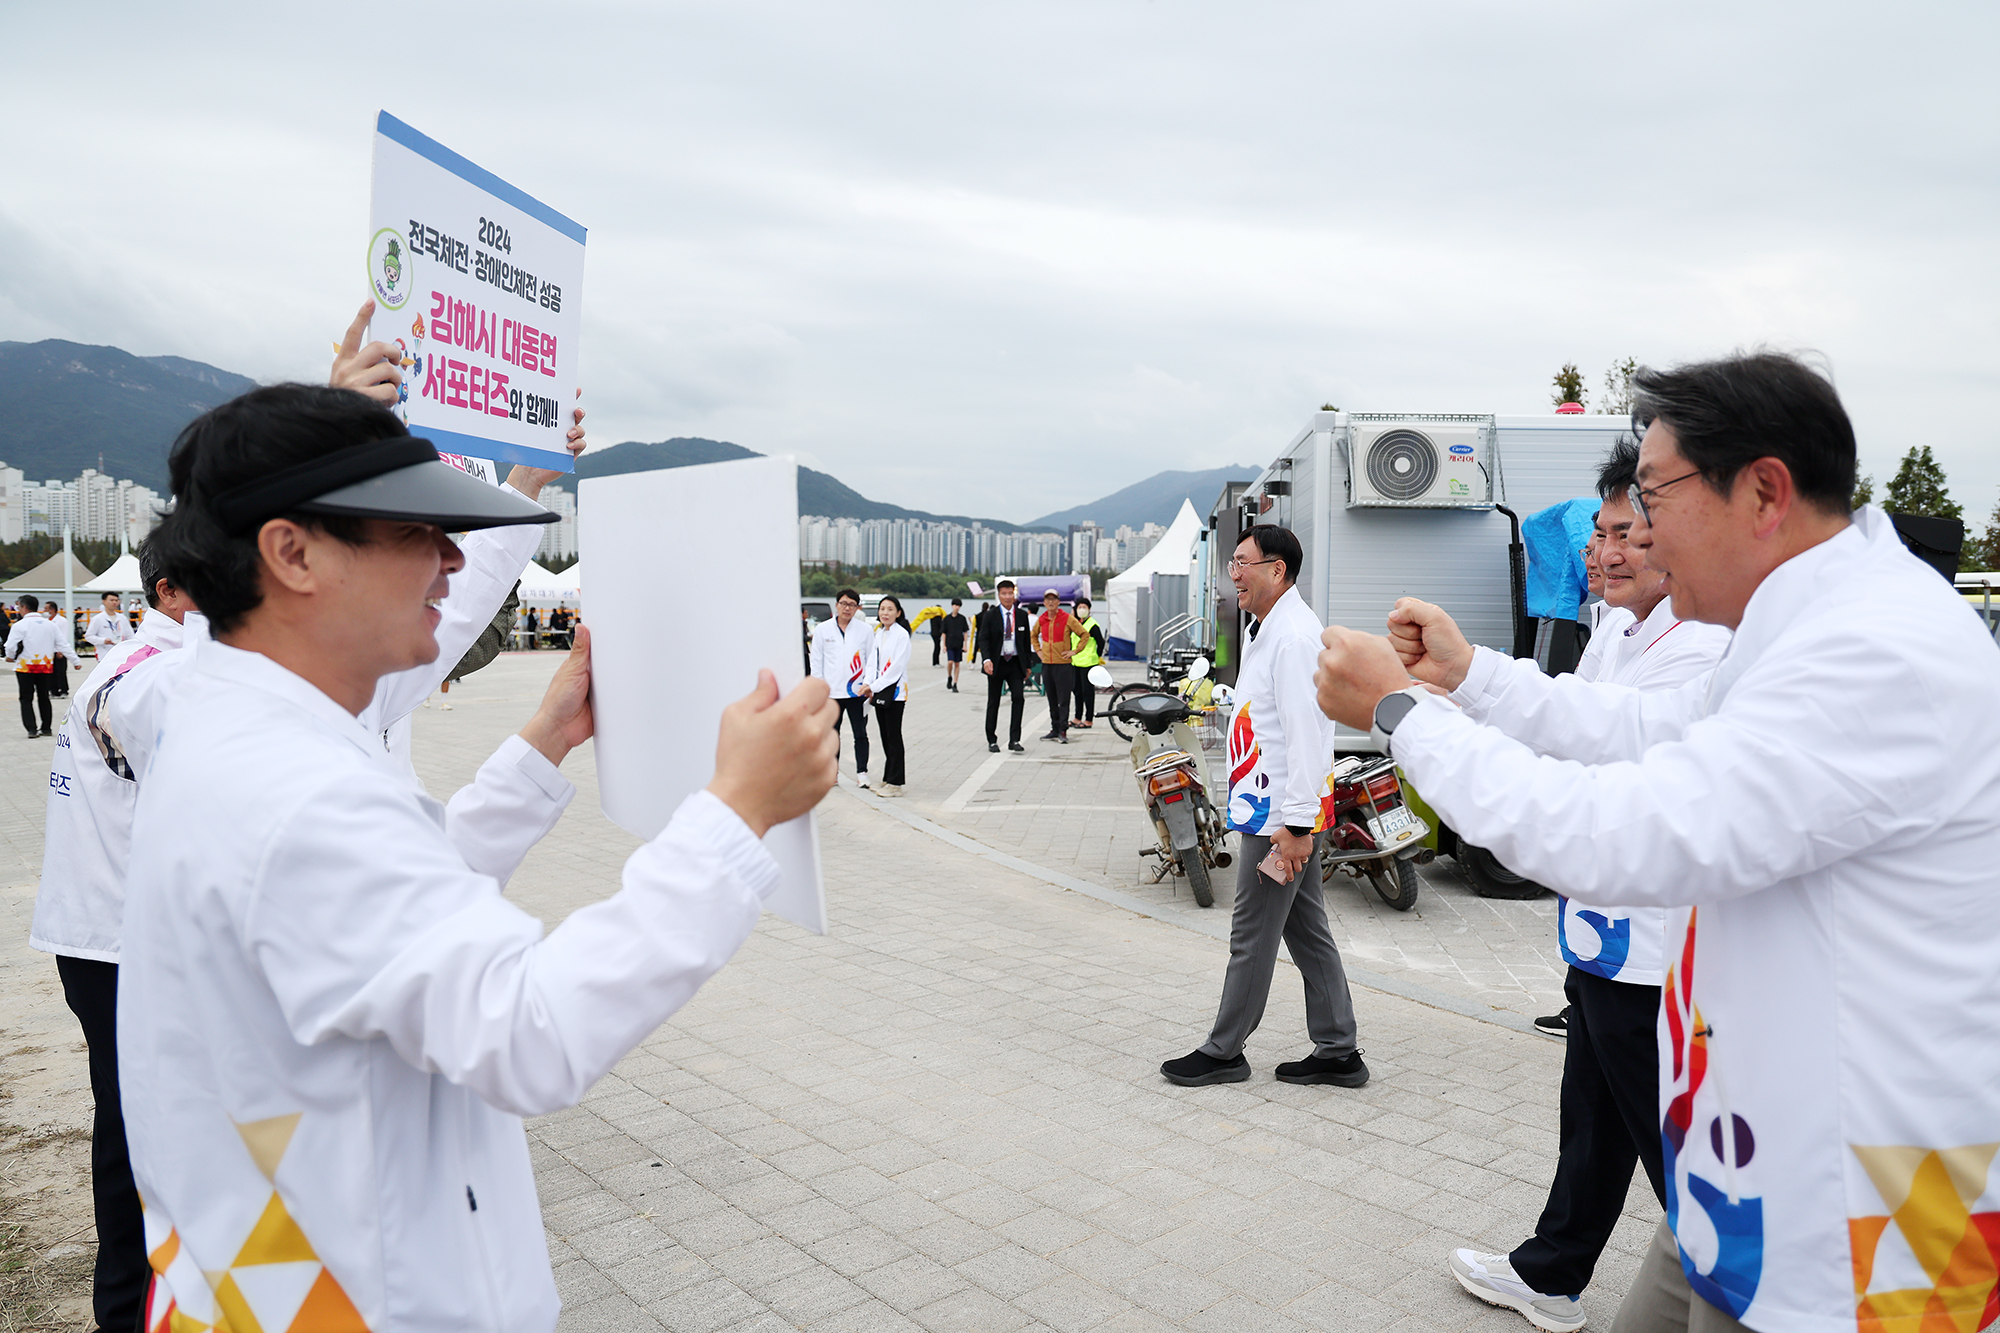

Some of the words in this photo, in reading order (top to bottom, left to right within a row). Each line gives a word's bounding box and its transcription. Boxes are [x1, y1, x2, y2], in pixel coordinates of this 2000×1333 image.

[478, 216, 512, 255] 2024
[408, 219, 538, 302] 전국체전·장애인체전
[540, 280, 562, 313] 성공
[430, 290, 496, 360] 김해시
[502, 318, 557, 378] 대동면
[421, 352, 524, 422] 서포터즈와
[526, 393, 560, 429] 함께!!
[56, 733, 71, 749] 024
[1386, 816, 1411, 833] 4331
